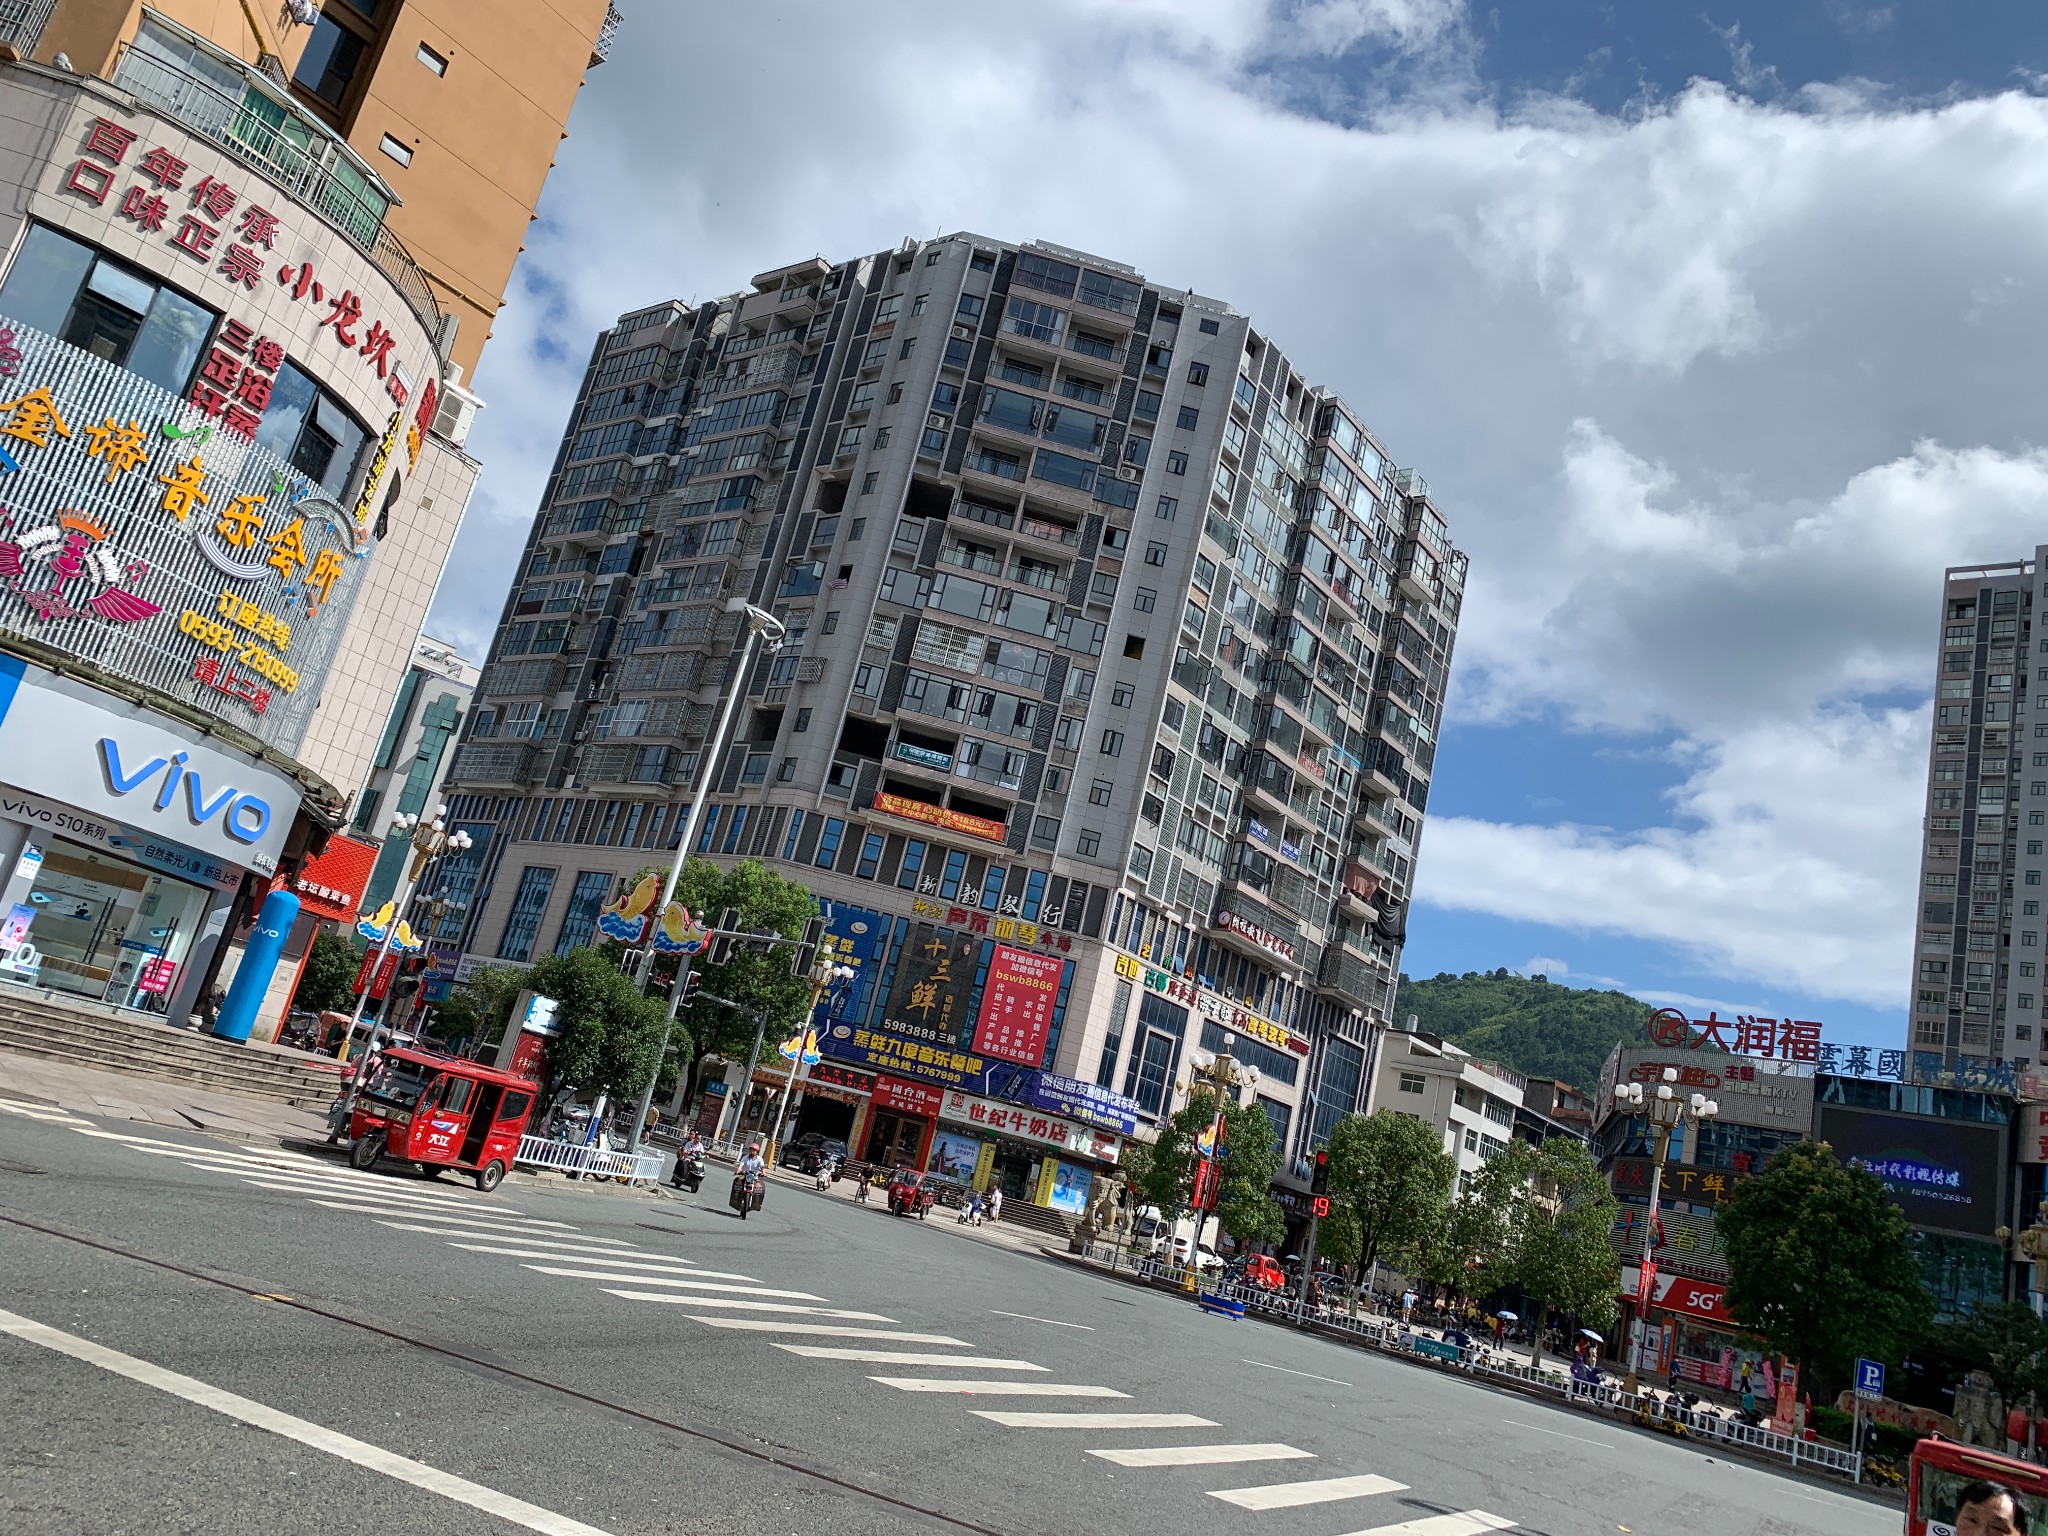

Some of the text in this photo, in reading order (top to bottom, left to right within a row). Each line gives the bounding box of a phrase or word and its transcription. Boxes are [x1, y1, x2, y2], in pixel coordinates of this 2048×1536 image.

[87, 117, 280, 249] 百年传承
[66, 157, 266, 289] 口味正宗
[220, 318, 285, 373] 三楼
[279, 262, 396, 380] 小龙坎
[202, 347, 274, 411] 足浴
[219, 589, 293, 651] 订座热线
[180, 610, 300, 693] 0593-2150999
[193, 655, 272, 715] 请上二楼
[98, 736, 271, 843] vivo
[2, 798, 107, 841] vivo S10系列
[144, 845, 239, 888] 自然柔光人像 新品上市
[296, 879, 351, 907] 老坛酸菜鱼
[919, 874, 1062, 926] 新韵琴行
[252, 924, 279, 938] vivo
[905, 937, 952, 1020] 十三鲜
[995, 968, 1053, 992] bswb8866
[1001, 951, 1058, 972] 朋友圈信息代发
[852, 1028, 984, 1077] 蒸鲜九度音乐餐吧
[883, 1018, 937, 1041] 5983888
[1690, 1011, 1823, 1062] 大润福
[1040, 1073, 1140, 1114] 微信朋友圈信息代发布平台
[427, 1132, 451, 1147] 大江
[969, 1102, 1070, 1144] 世纪牛奶店
[1312, 1196, 1330, 1217] 19
[1863, 1364, 1880, 1387] P
